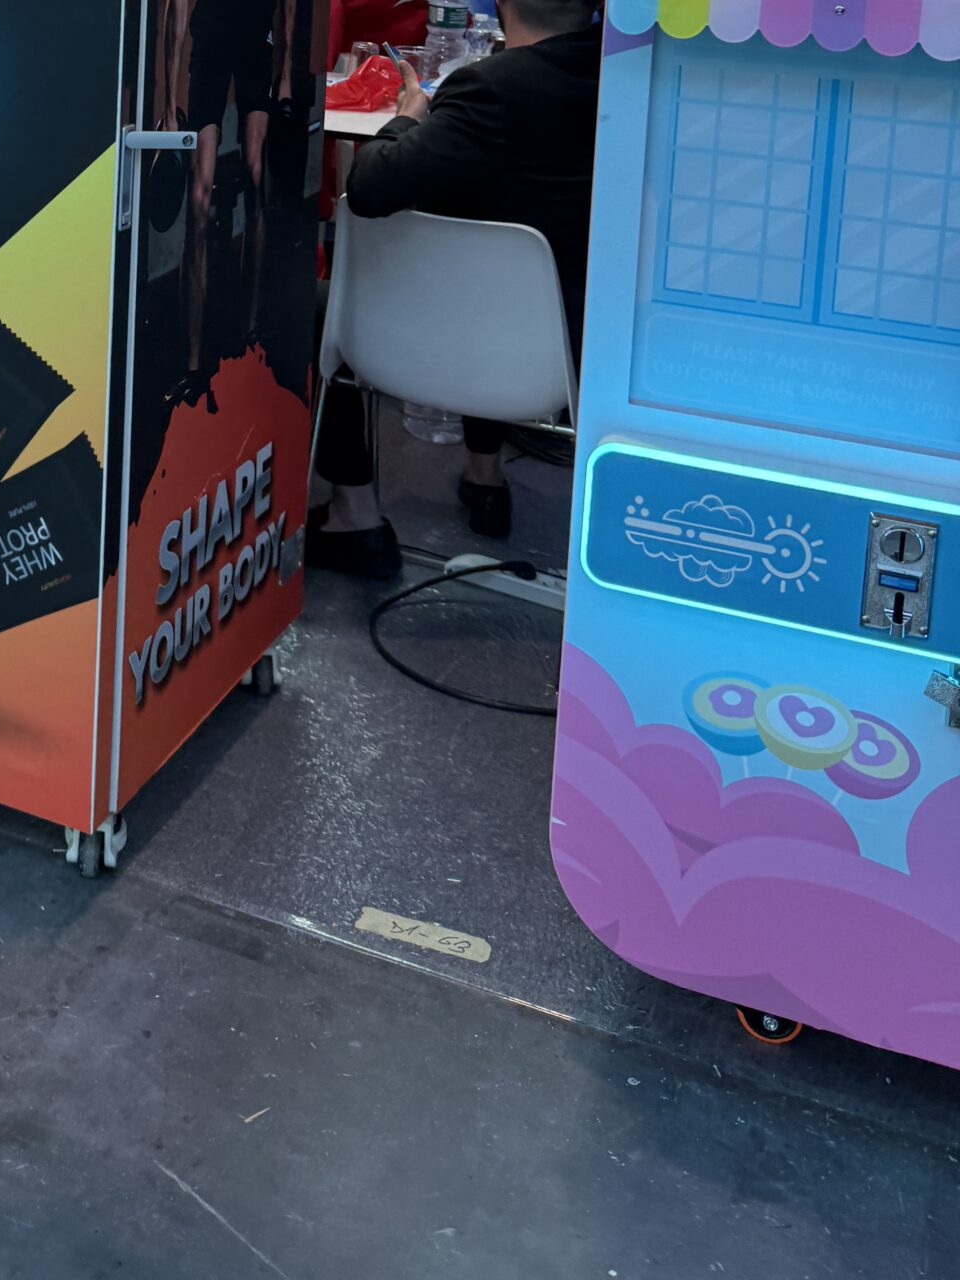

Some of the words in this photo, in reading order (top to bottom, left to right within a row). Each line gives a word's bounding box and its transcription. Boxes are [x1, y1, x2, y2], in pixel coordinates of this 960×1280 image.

[2, 542, 63, 585] WHEY
[155, 441, 273, 605] SHAPE
[128, 583, 211, 705] YOUR
[217, 511, 286, 622] BODY
